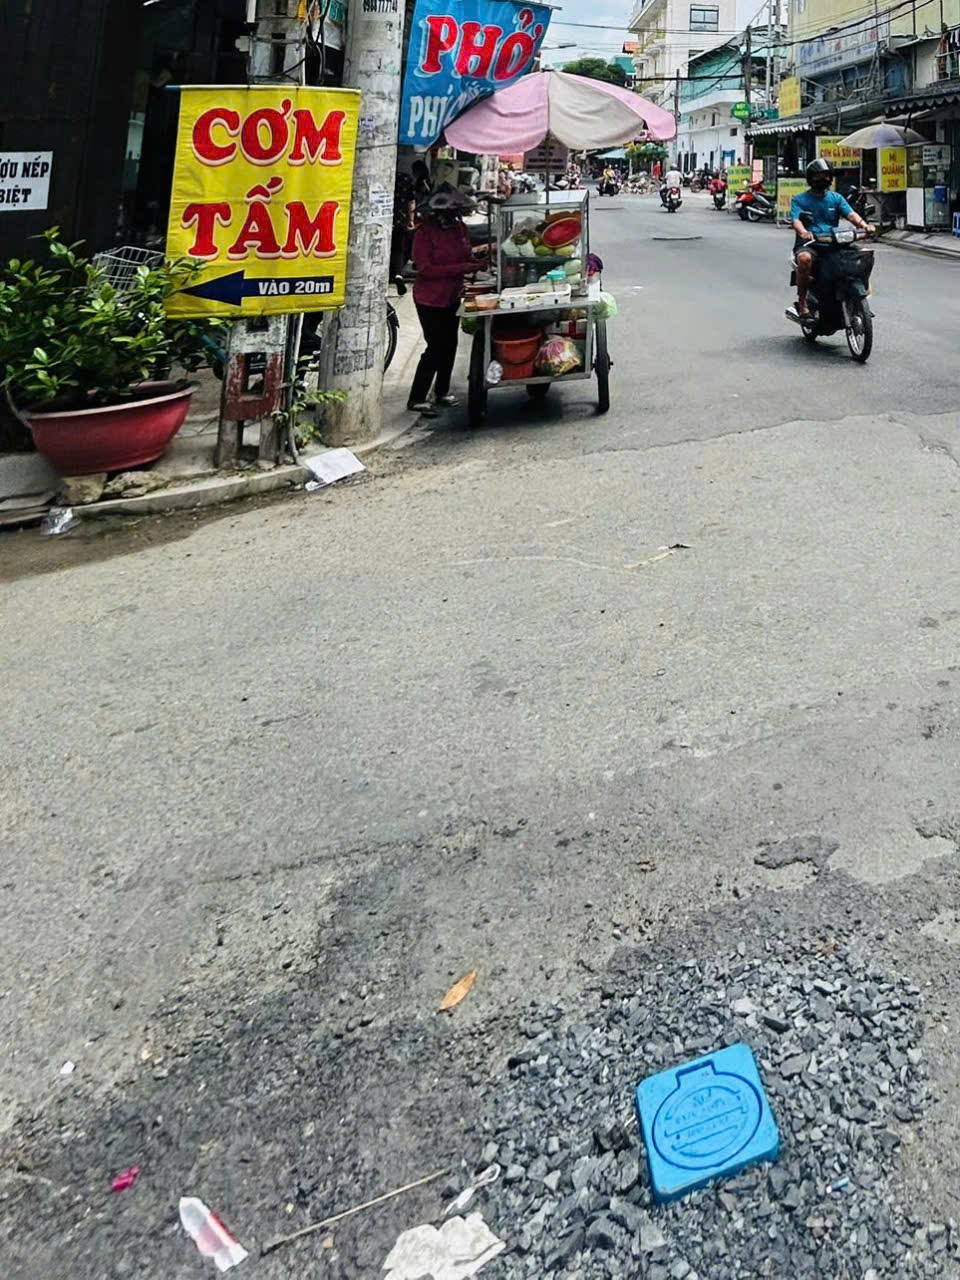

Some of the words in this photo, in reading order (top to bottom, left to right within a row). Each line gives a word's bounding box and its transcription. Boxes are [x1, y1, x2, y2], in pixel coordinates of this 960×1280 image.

[416, 8, 543, 81] PHỞ
[192, 98, 345, 166] CƠM
[181, 176, 340, 260] TẤM
[258, 280, 290, 295] VÀO
[294, 280, 331, 294] 20m
